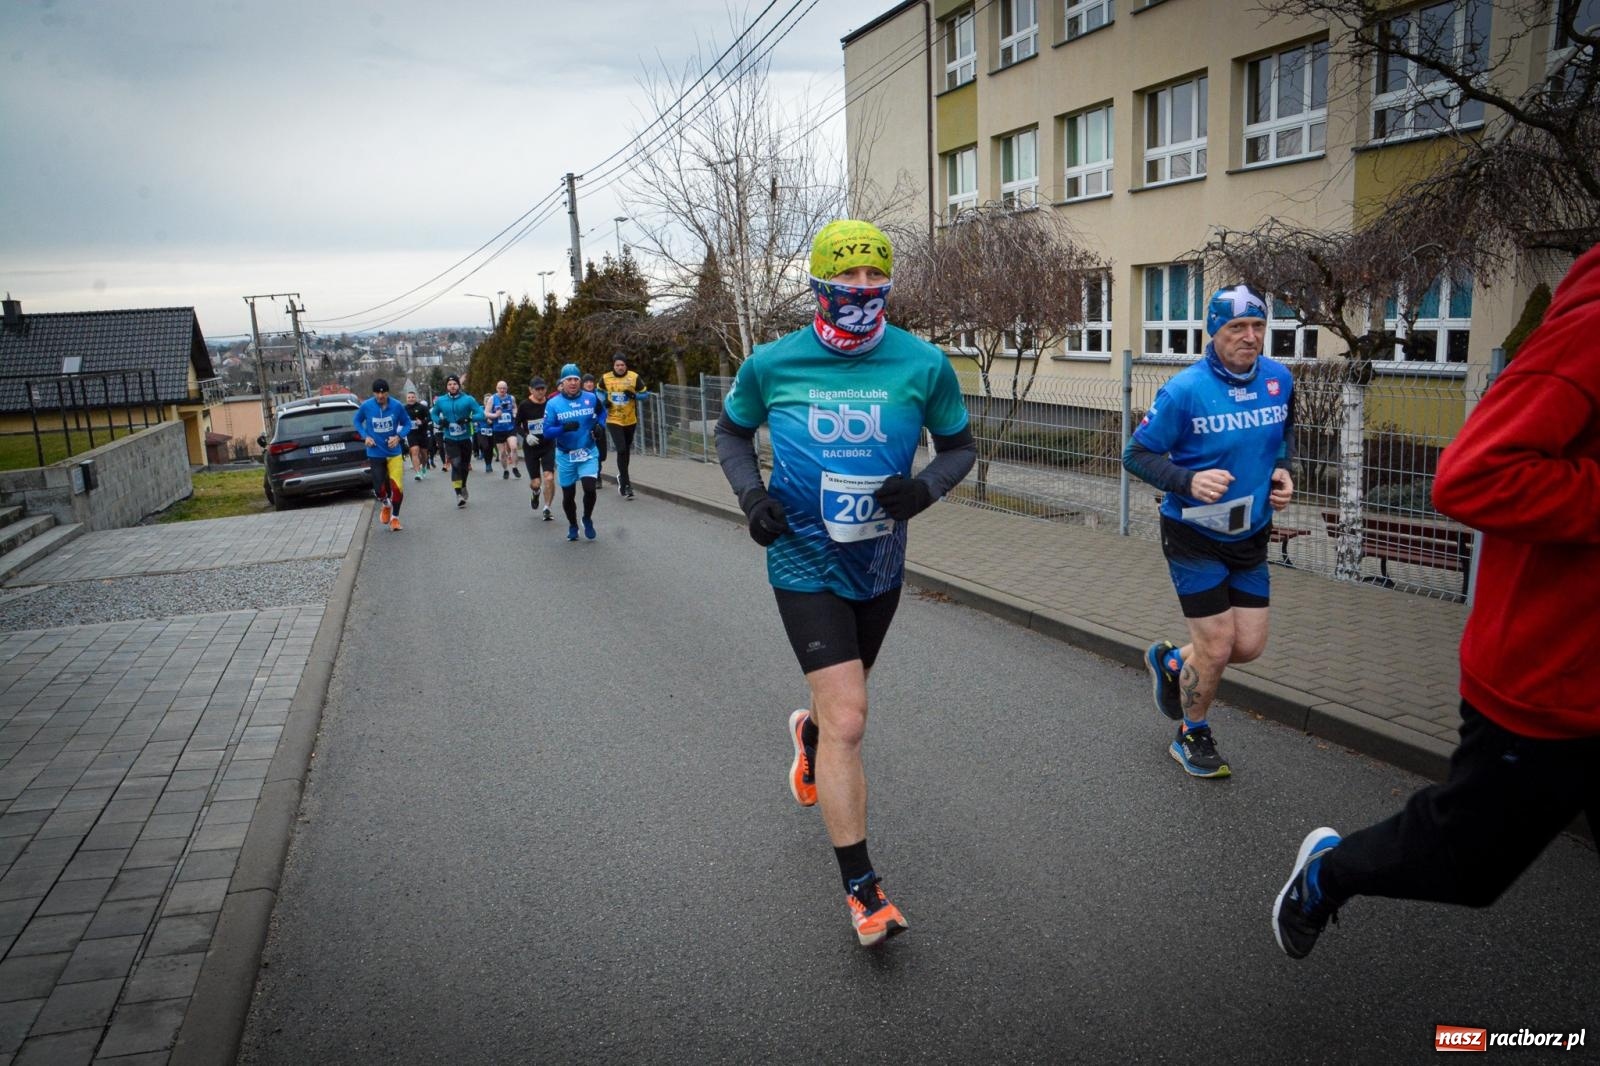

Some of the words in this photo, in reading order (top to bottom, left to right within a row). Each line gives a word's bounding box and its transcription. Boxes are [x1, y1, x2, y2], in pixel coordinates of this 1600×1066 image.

[833, 243, 871, 262] XYZ
[836, 298, 884, 326] 29
[809, 389, 888, 400] BiegamBoLubię
[808, 403, 887, 443] bbl
[1192, 403, 1288, 434] RUNNERS
[823, 448, 872, 458] RACIBÓRZ
